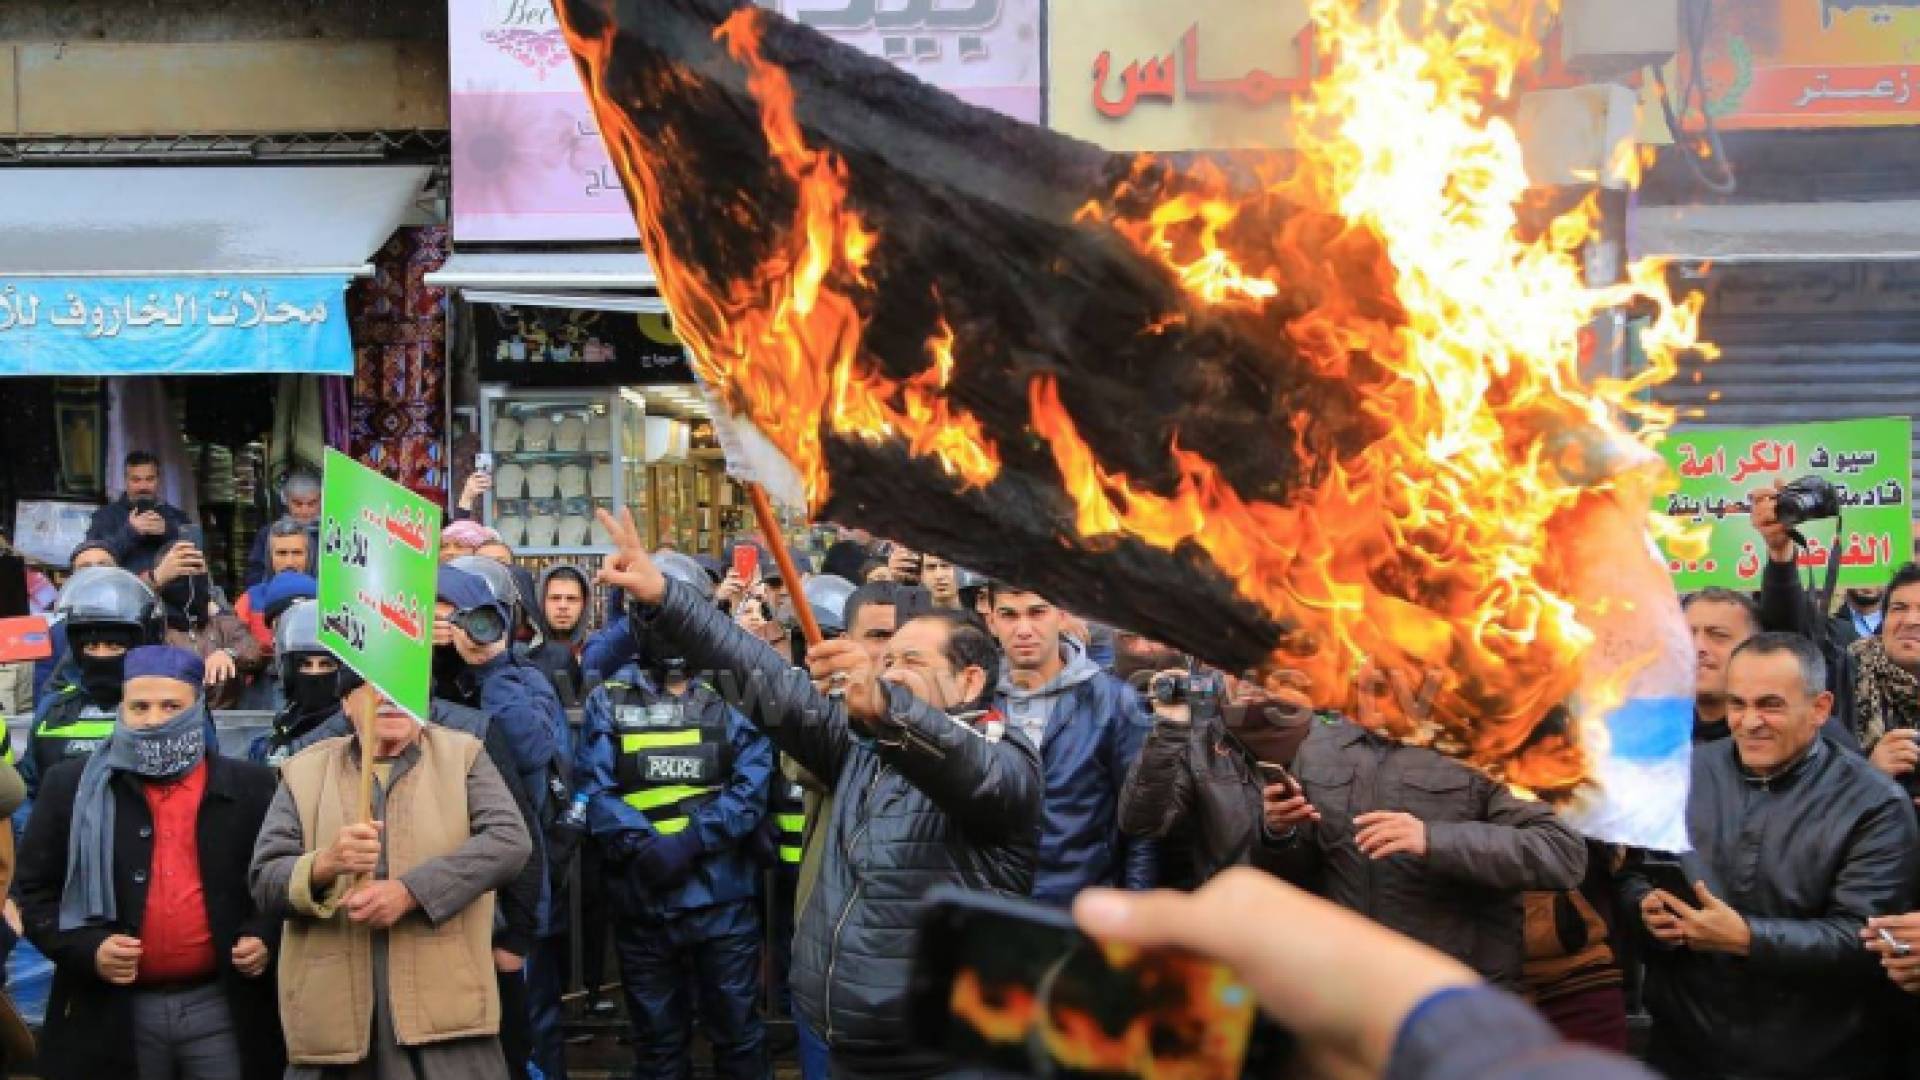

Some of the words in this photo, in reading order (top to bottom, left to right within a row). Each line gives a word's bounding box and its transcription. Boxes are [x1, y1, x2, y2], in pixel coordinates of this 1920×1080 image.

[1793, 69, 1911, 107] زعتر
[51, 292, 197, 338] الخاروف
[206, 286, 328, 328] محلات
[1677, 440, 1797, 483] الكرامة
[1808, 444, 1876, 475] سيوف
[650, 758, 702, 778] POLICE
